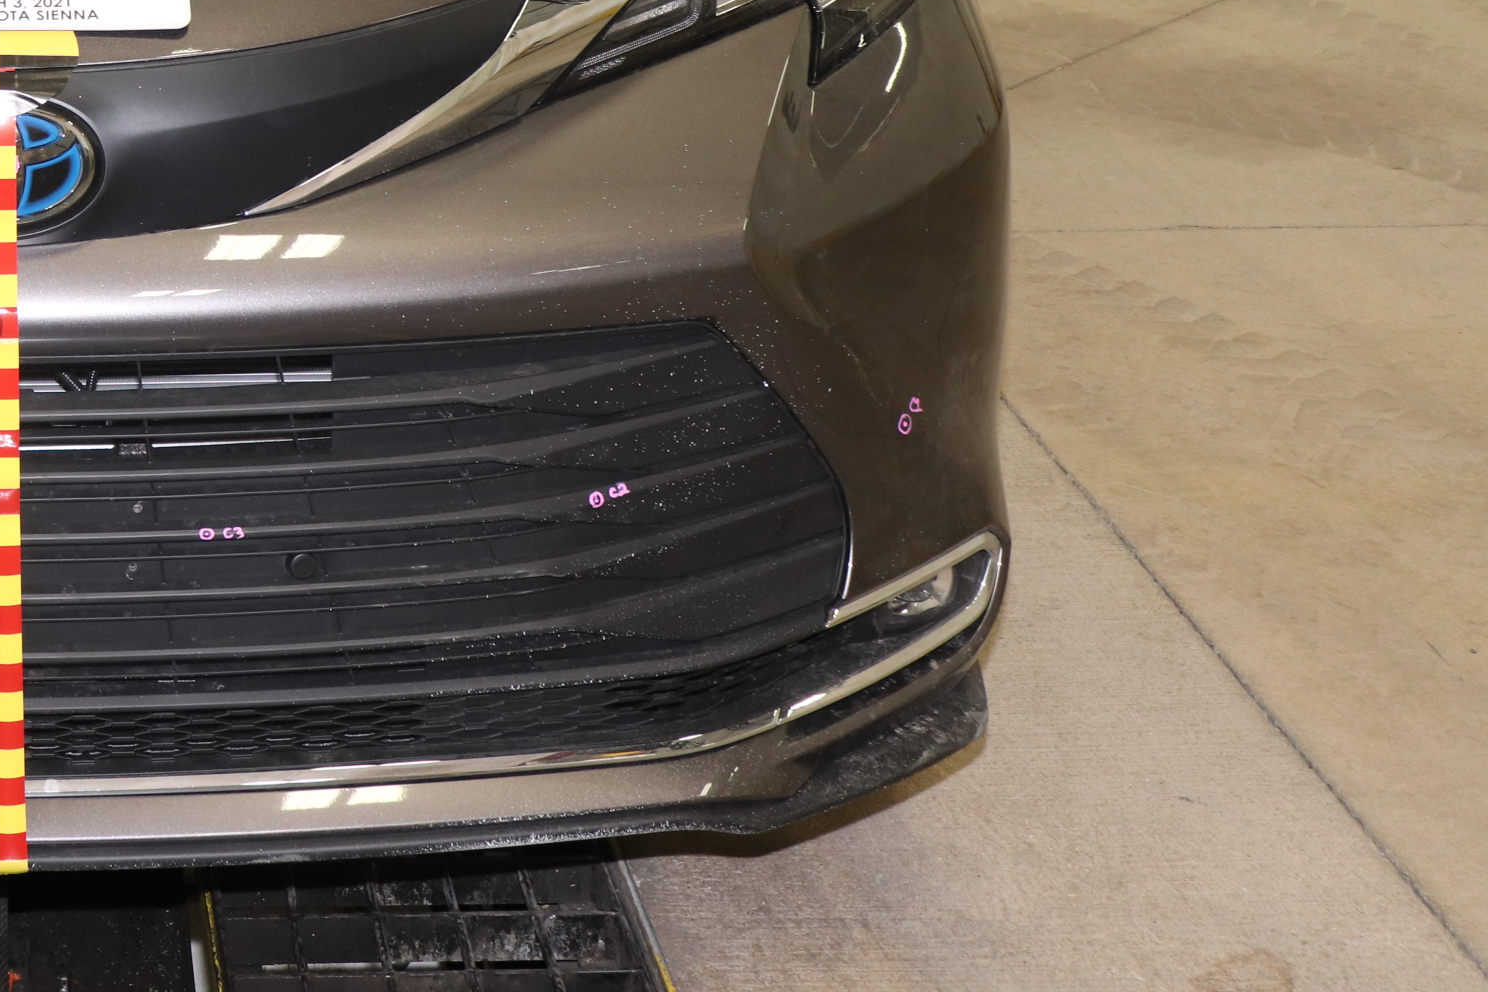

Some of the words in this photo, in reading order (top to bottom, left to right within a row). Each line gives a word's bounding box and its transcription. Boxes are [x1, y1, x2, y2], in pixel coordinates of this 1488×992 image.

[36, 9, 99, 21] SIENNA
[609, 482, 630, 498] C2
[223, 526, 245, 539] C3
